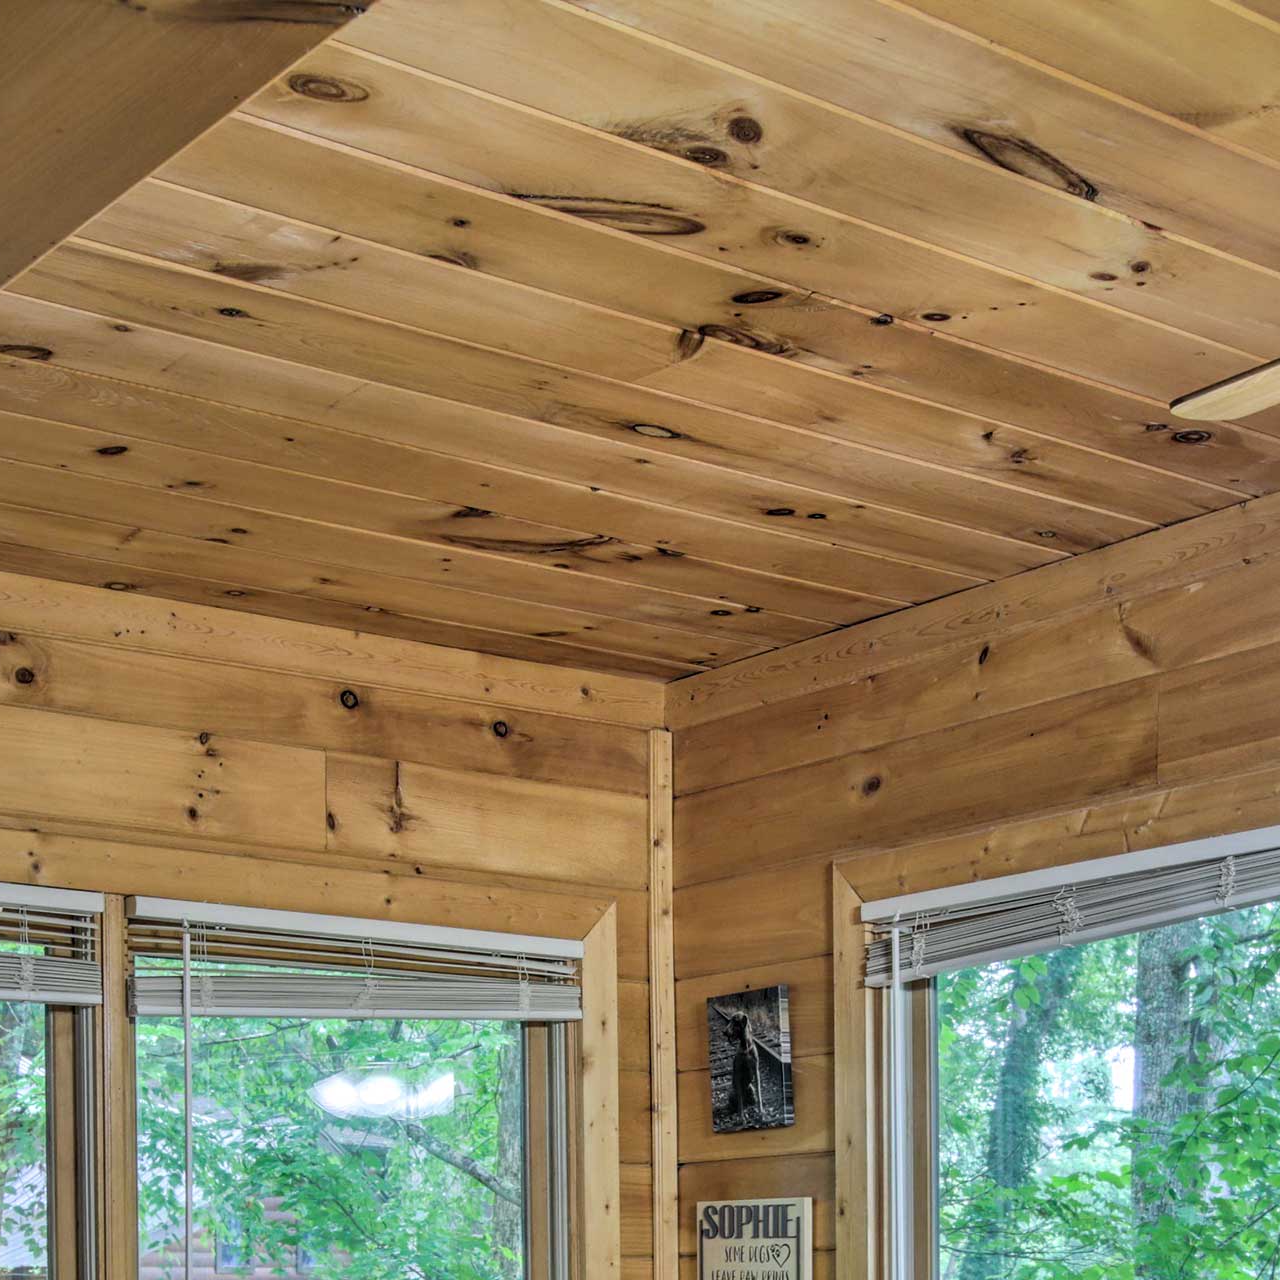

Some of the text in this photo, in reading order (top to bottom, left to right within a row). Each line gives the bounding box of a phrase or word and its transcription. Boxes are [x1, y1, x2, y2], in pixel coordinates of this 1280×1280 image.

[703, 1204, 797, 1239] SOPHIE
[725, 1245, 770, 1263] SOME DOGS
